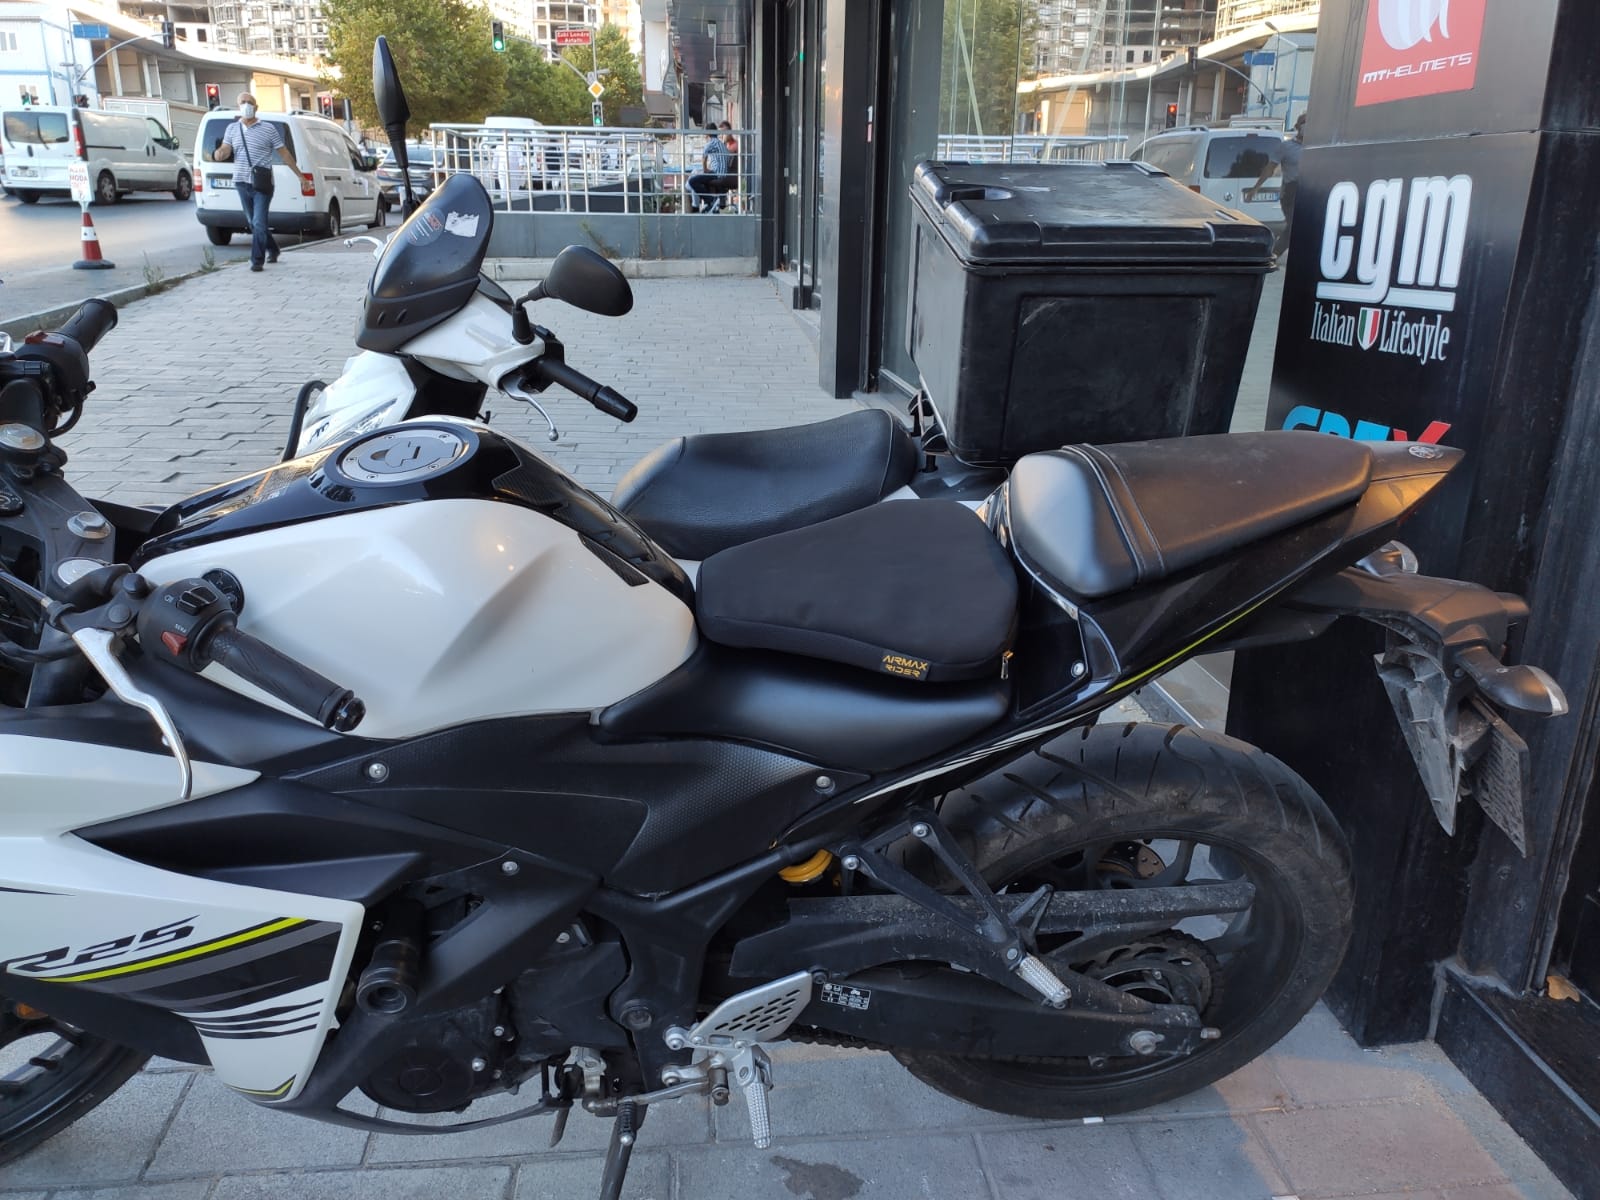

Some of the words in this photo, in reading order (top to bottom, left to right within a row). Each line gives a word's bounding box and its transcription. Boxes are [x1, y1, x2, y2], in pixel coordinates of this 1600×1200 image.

[1316, 174, 1473, 305] cgm
[1310, 301, 1356, 347] Italian
[1378, 308, 1451, 366] Lifestyle
[882, 655, 928, 671] AIRMAX
[885, 664, 920, 678] RIDER
